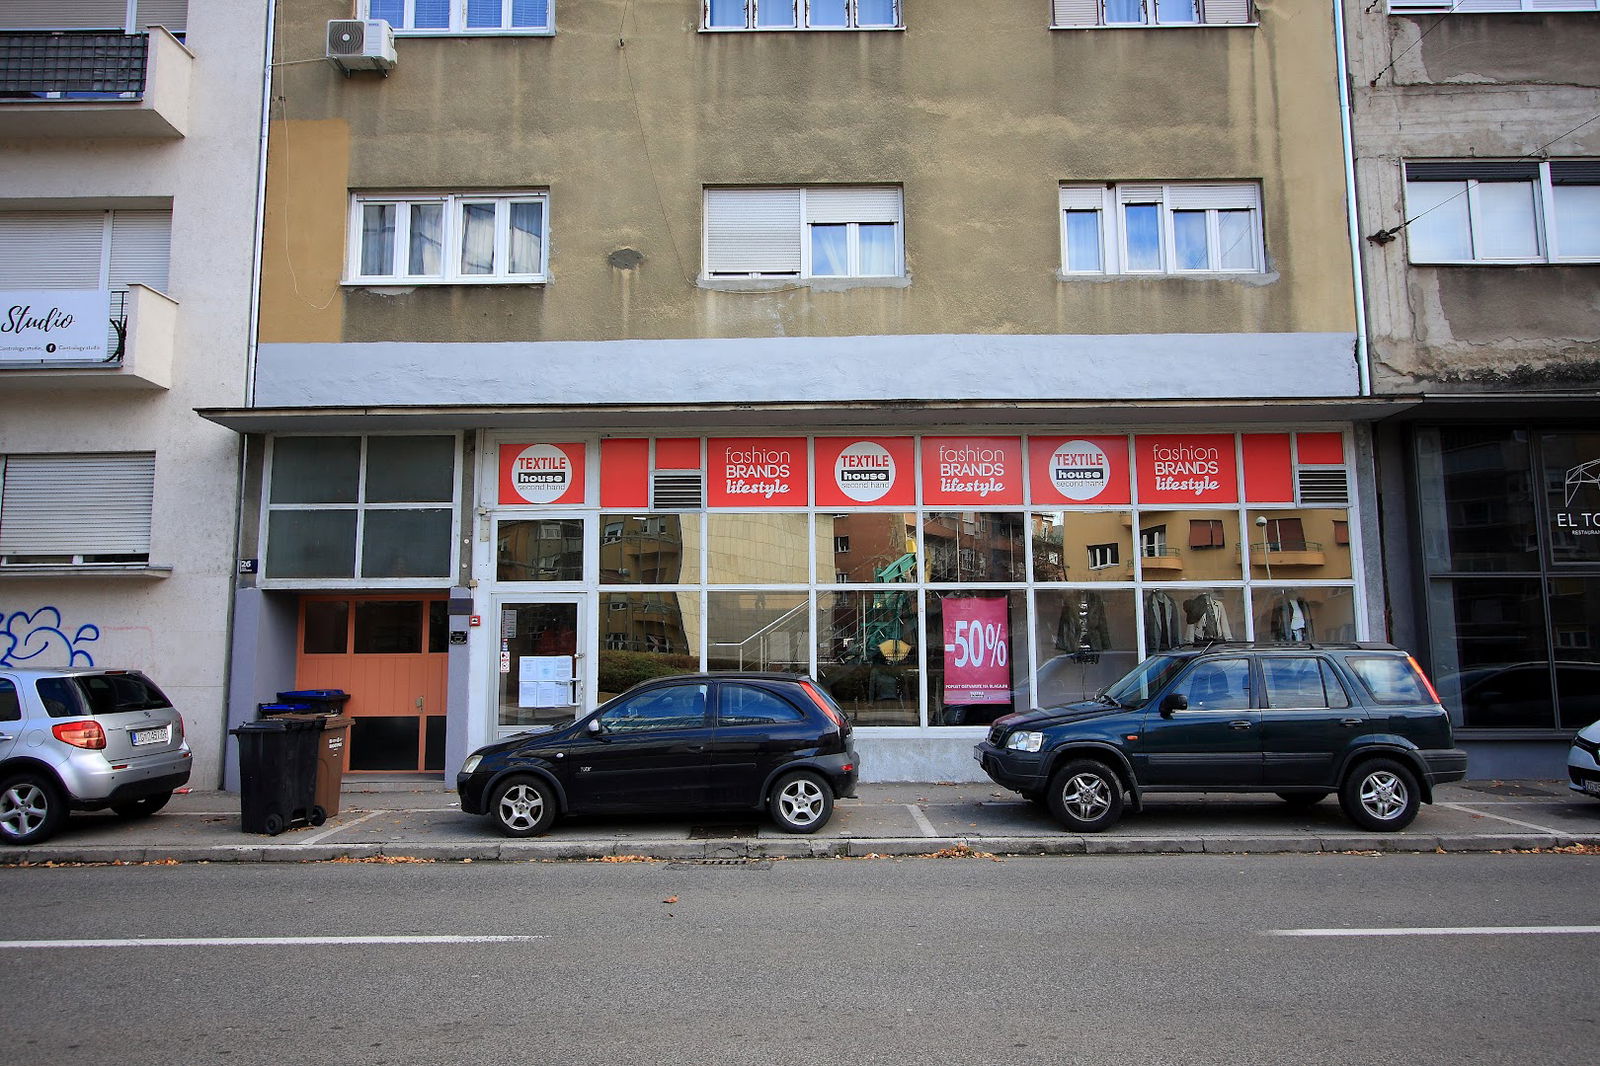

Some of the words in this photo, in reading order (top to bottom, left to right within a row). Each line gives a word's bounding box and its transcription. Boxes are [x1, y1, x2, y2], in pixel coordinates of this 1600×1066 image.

[1, 305, 74, 334] Studio
[725, 446, 790, 464] fashion
[939, 444, 1005, 462] fashion
[1153, 443, 1219, 461] fashion
[518, 457, 566, 470] TEXTILE
[841, 455, 890, 468] TEXTILE
[1055, 453, 1103, 466] TEXTILE
[726, 464, 790, 478] BRANDS
[940, 463, 1005, 477] BRANDS
[1058, 470, 1101, 479] house
[1154, 461, 1219, 475] BRANDS
[520, 473, 563, 483] house
[843, 471, 887, 481] house
[726, 479, 791, 499] lifestyle
[940, 477, 1006, 497] lifestyle
[1155, 475, 1220, 496] lifestyle
[1557, 513, 1578, 527] EL
[241, 560, 252, 568] 26
[944, 620, 1007, 668] -50%
